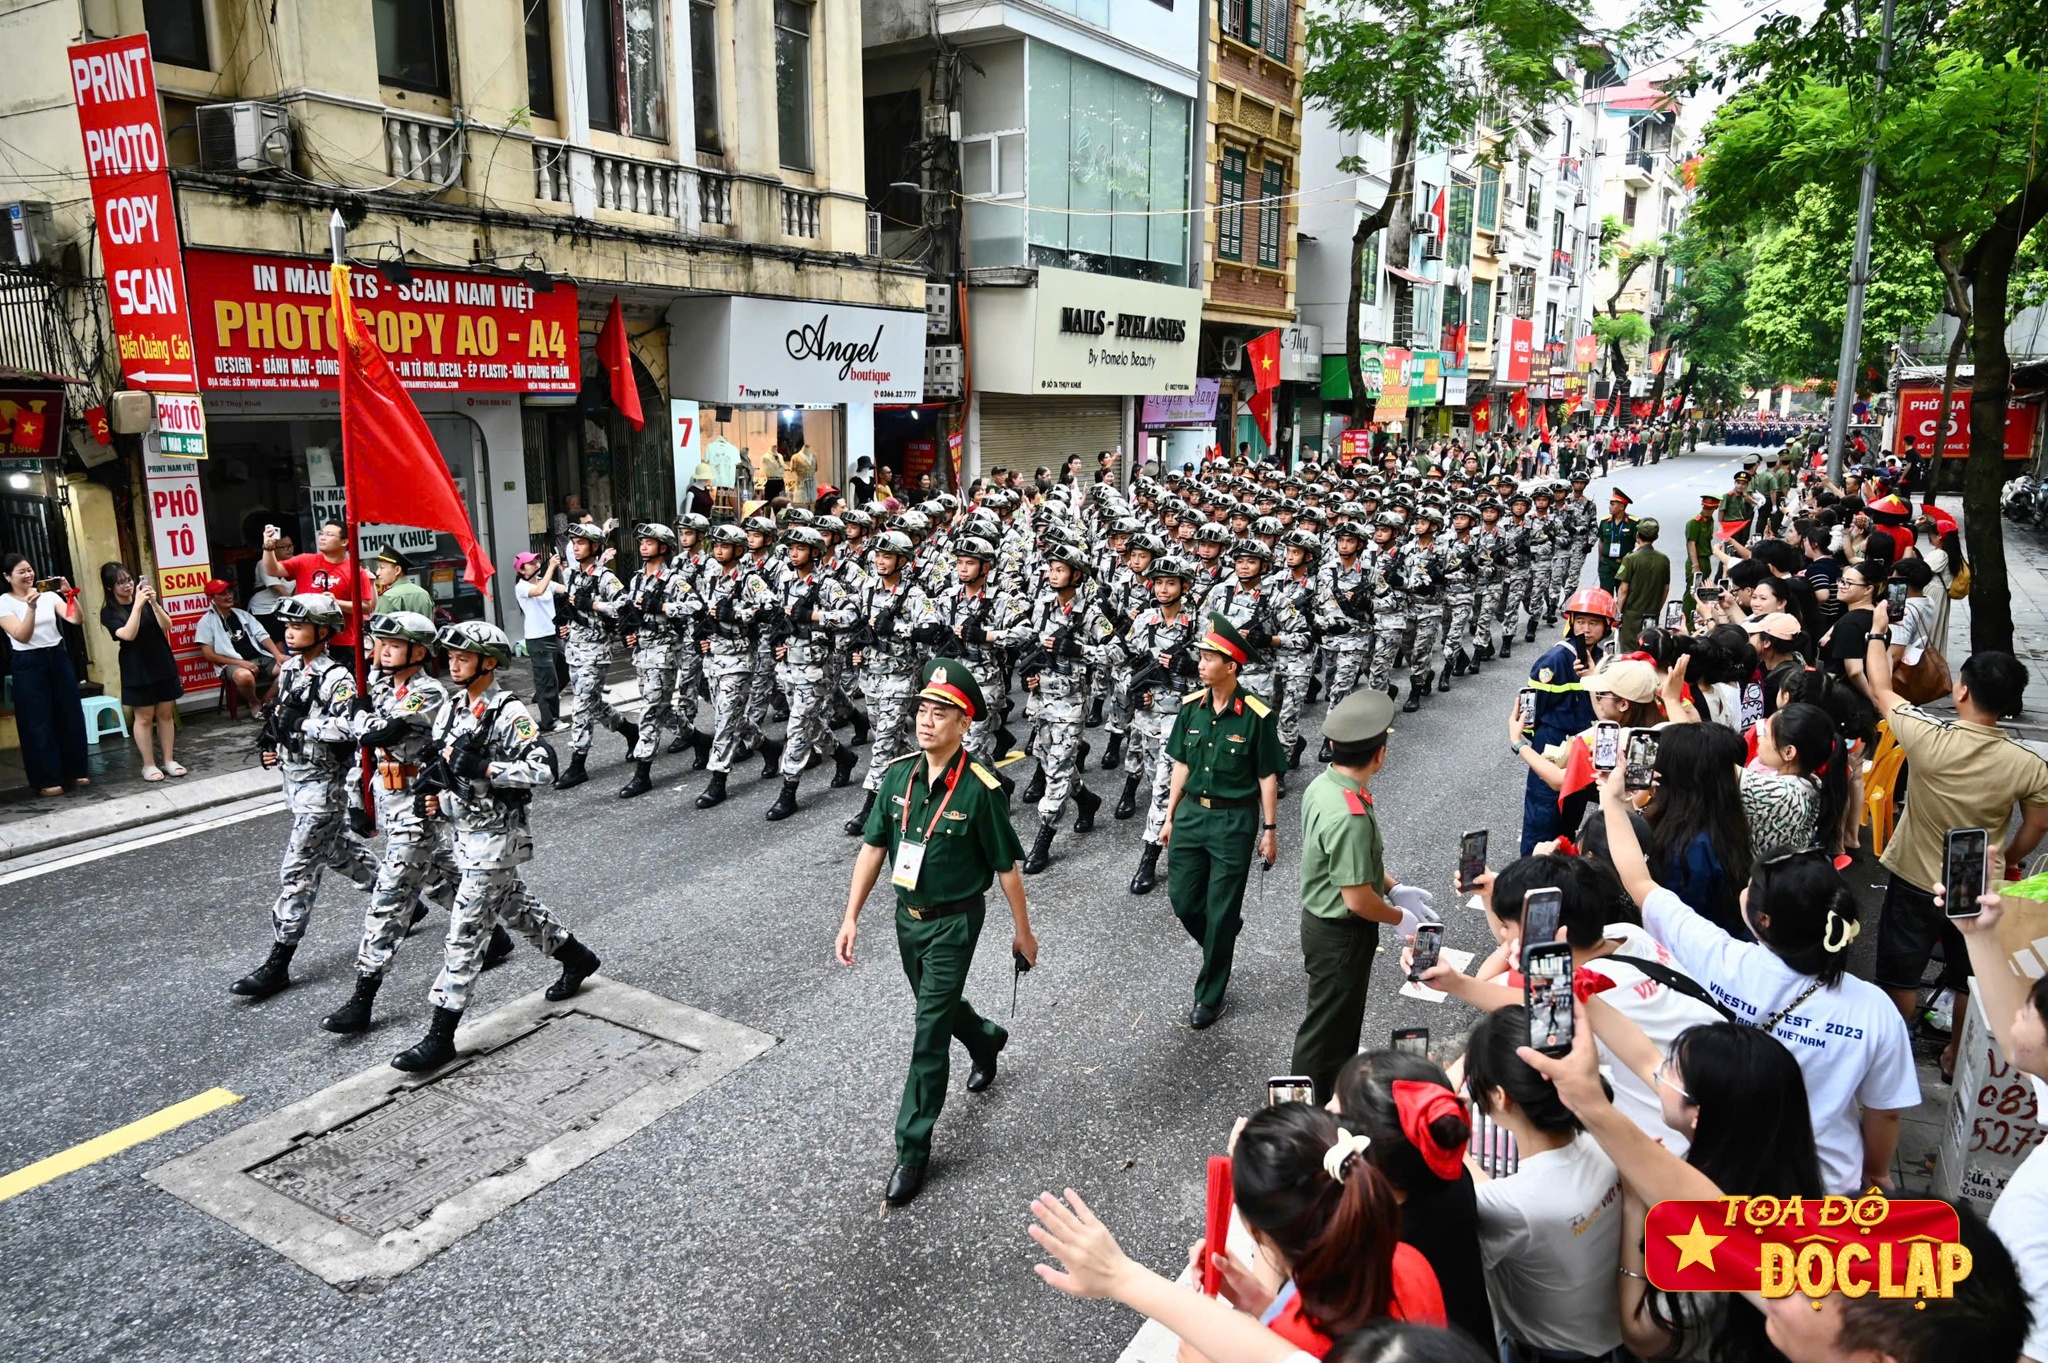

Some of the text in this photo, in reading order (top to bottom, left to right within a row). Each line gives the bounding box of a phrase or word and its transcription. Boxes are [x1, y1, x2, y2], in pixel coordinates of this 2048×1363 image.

[72, 48, 147, 106] PRINT
[86, 122, 160, 177] PHOTO
[105, 195, 159, 245] COPY
[115, 267, 177, 315] SCAN
[252, 265, 278, 292] IN
[284, 264, 332, 296] MÀU
[347, 273, 379, 299] TS
[398, 277, 450, 304] SCAN
[455, 281, 496, 307] NAM
[501, 282, 535, 314] VIỆT
[1060, 307, 1105, 336] NAILS
[1116, 313, 1186, 343] EYELASHES
[171, 334, 191, 361] Cáo
[528, 319, 567, 359] A4
[785, 313, 884, 381] Angel
[214, 356, 253, 374] DESIGN
[263, 355, 289, 375] ĐÁNH
[480, 364, 508, 379] PLASTIC
[1088, 349, 1156, 370] By Pomelo Beauty
[850, 367, 891, 384] boutique
[739, 385, 745, 397] 7
[1910, 398, 1940, 411] PHỞ
[158, 400, 201, 431] PHÔ TÔ
[678, 417, 693, 448] 7
[167, 464, 181, 472] NAM
[153, 483, 199, 519] PHÔ
[313, 487, 346, 502] IN MÀ
[166, 523, 195, 557] TÔ
[164, 571, 208, 591] SCAN
[168, 596, 210, 613] IN MÀU
[1777, 1027, 1827, 1049] VIETNAM
[1784, 1014, 1813, 1029] EST
[1825, 1022, 1864, 1041] 2023
